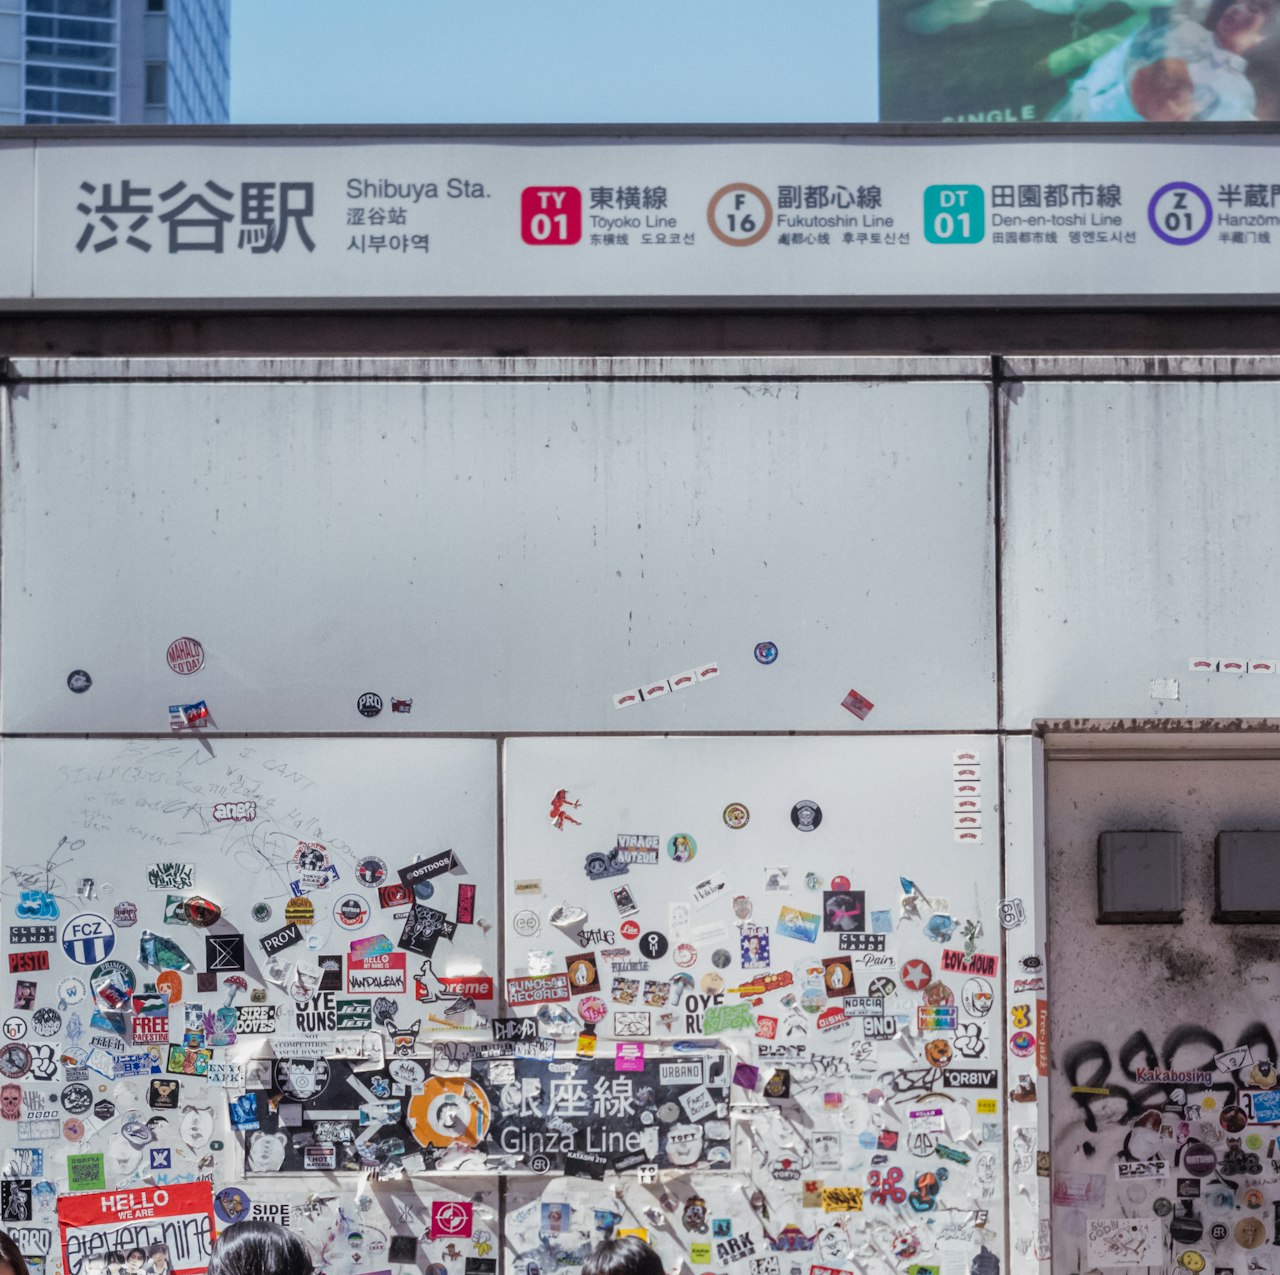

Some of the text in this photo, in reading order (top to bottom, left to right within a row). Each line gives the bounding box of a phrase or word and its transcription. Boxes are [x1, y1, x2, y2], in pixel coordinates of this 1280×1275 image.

[346, 178, 491, 204] Shibuya Sta.
[537, 191, 567, 208] TY
[589, 185, 668, 211] 東横線
[777, 184, 882, 211] 副都心線
[939, 190, 969, 208] DT
[991, 183, 1122, 210] 田園都市線
[734, 194, 746, 211] F
[1173, 192, 1188, 210] Z
[75, 178, 317, 254] 渋谷駅
[646, 214, 677, 229] Line
[726, 213, 756, 233] 16
[777, 214, 895, 229] Fukutoshin Line
[991, 212, 1123, 228] Den-en-toshi Line
[1165, 213, 1194, 231] 01
[530, 213, 568, 240] 01
[933, 212, 972, 239] 01
[346, 233, 430, 254] 시부야역
[640, 231, 696, 246] 도요코선
[841, 231, 911, 246] 후쿠토신선
[357, 693, 382, 711] PRO
[619, 835, 659, 848] VIRAGE
[11, 926, 56, 934] CLEAN
[72, 922, 103, 938] FCZ
[11, 935, 56, 943] HANDS
[263, 927, 297, 952] PROV
[840, 943, 885, 951] HANDS
[9, 952, 50, 973] PESTO
[944, 951, 996, 974] LOVE HOUR
[510, 988, 569, 1002] RECORDS
[240, 1008, 269, 1019] SIRE
[296, 1011, 336, 1032] RUNS
[133, 1017, 169, 1033] FREE
[132, 1033, 169, 1042] PALESTINE
[661, 1065, 700, 1079] URBANO
[1136, 1067, 1212, 1085] Kakabosing
[500, 1125, 640, 1153] Ginza Line
[773, 1170, 800, 1181] TOKYO
[101, 1190, 169, 1213] HELLO
[252, 1204, 290, 1215] SIDE
[117, 1208, 155, 1220] WE ARE
